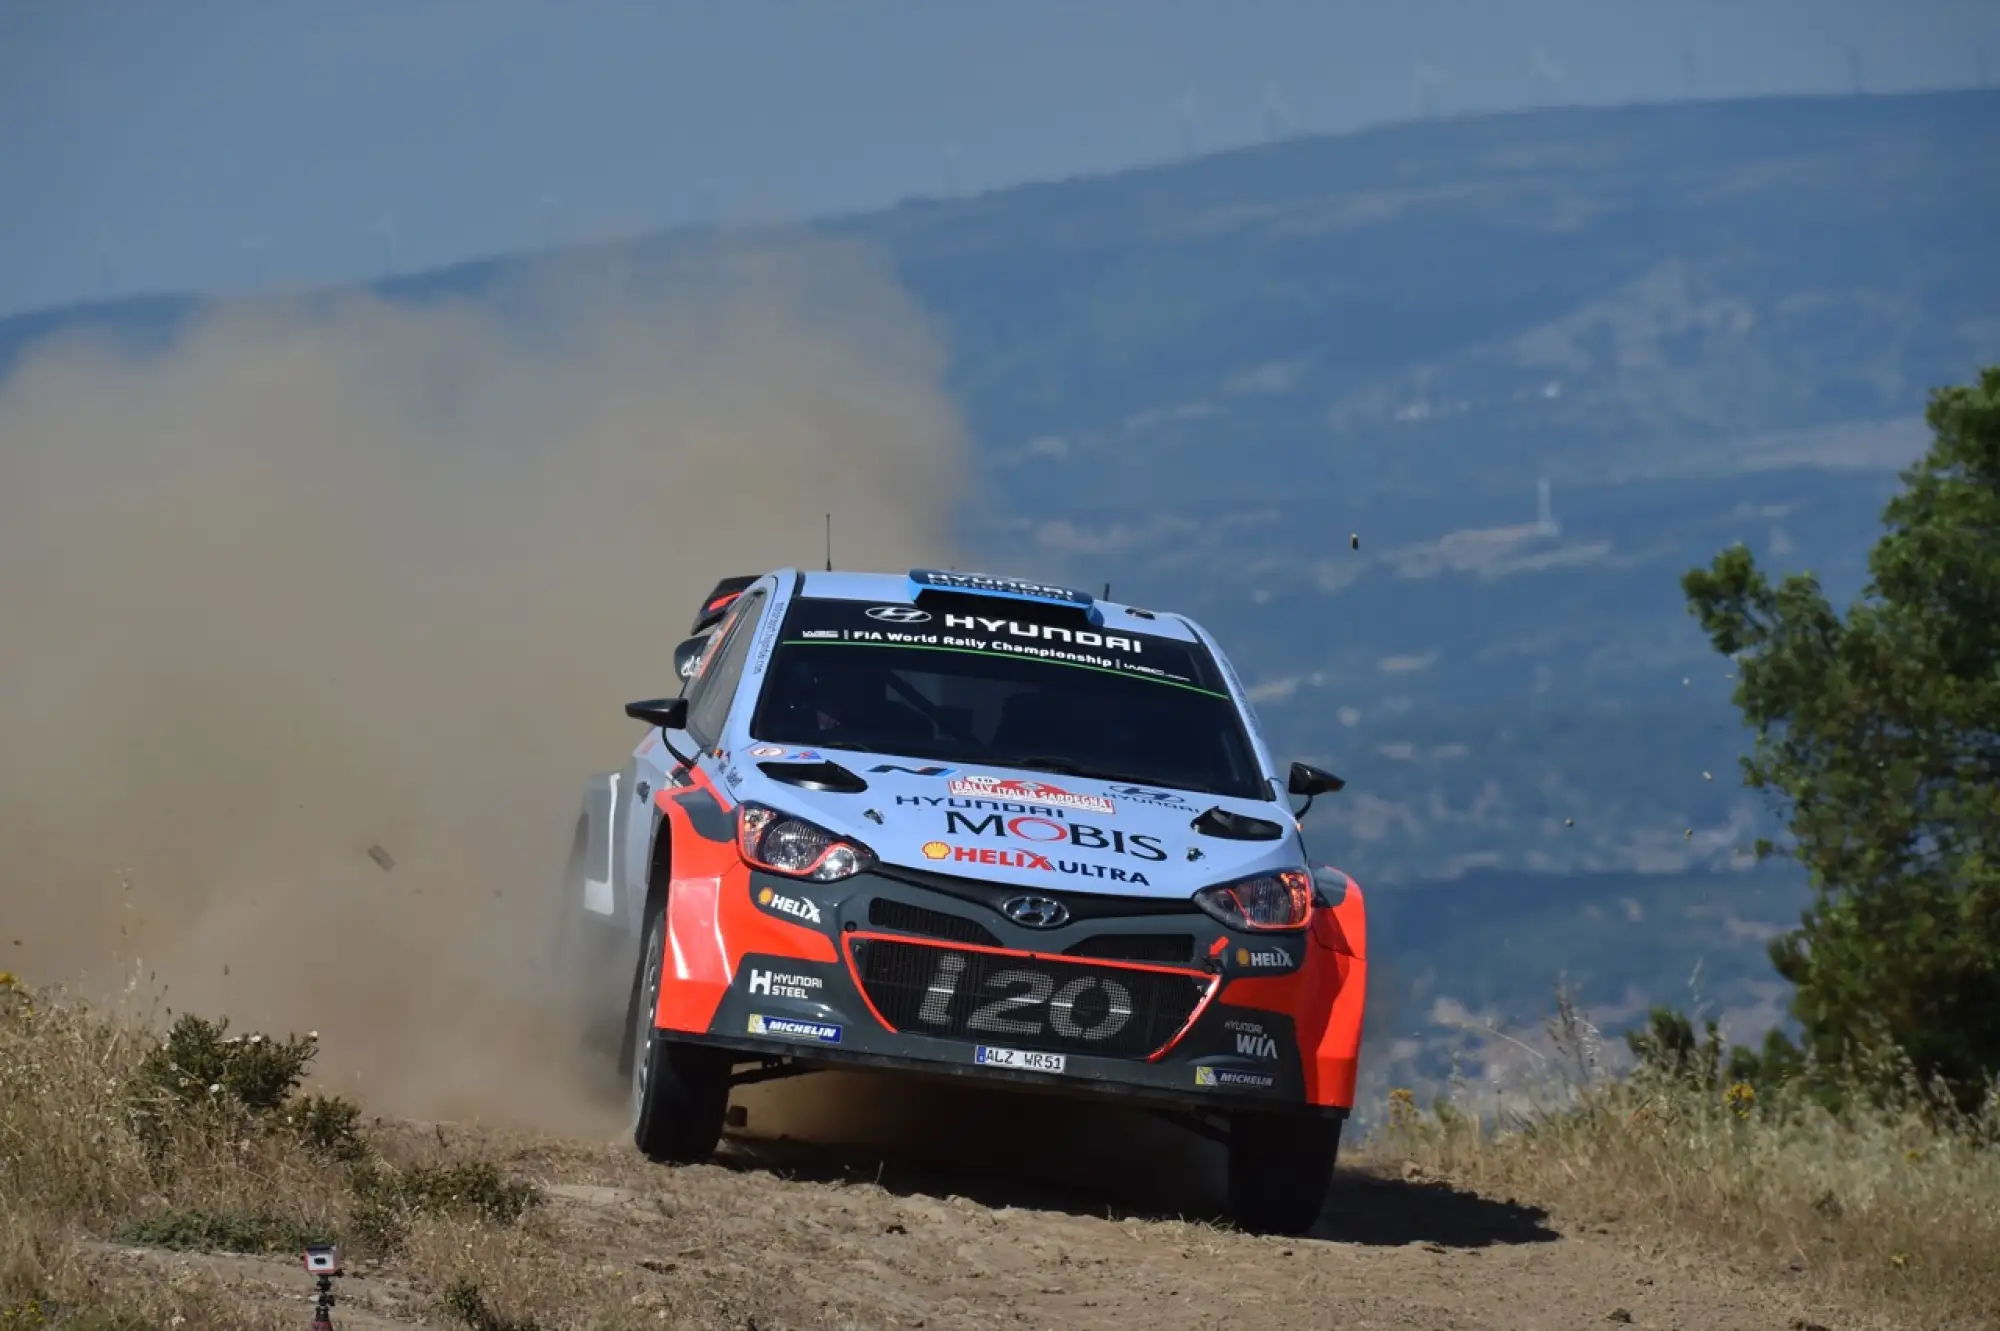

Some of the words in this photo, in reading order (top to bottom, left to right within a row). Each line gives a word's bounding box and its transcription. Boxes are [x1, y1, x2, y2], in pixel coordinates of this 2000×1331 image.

[945, 613, 1142, 653] HYUNDAI
[853, 631, 882, 640] FIA
[887, 632, 937, 643] World
[943, 637, 986, 649] Rally
[991, 641, 1112, 668] Championship
[954, 780, 993, 795] RALLY
[996, 786, 1037, 799] ITALIA
[1038, 792, 1108, 809] SARDEGNA
[896, 795, 1064, 818] HYUNDAI
[946, 811, 1167, 861] MOBIS
[954, 847, 1057, 872] HELIX
[1058, 860, 1150, 886] ULTRA
[770, 895, 821, 924] HELIX
[1251, 947, 1293, 968] HELIX
[773, 972, 823, 988] HYUNDAI
[772, 985, 808, 999] STEEL
[769, 1020, 837, 1038] MICHELIN
[986, 1049, 1014, 1065] ALZ
[1219, 1073, 1275, 1088] MICHELIN
